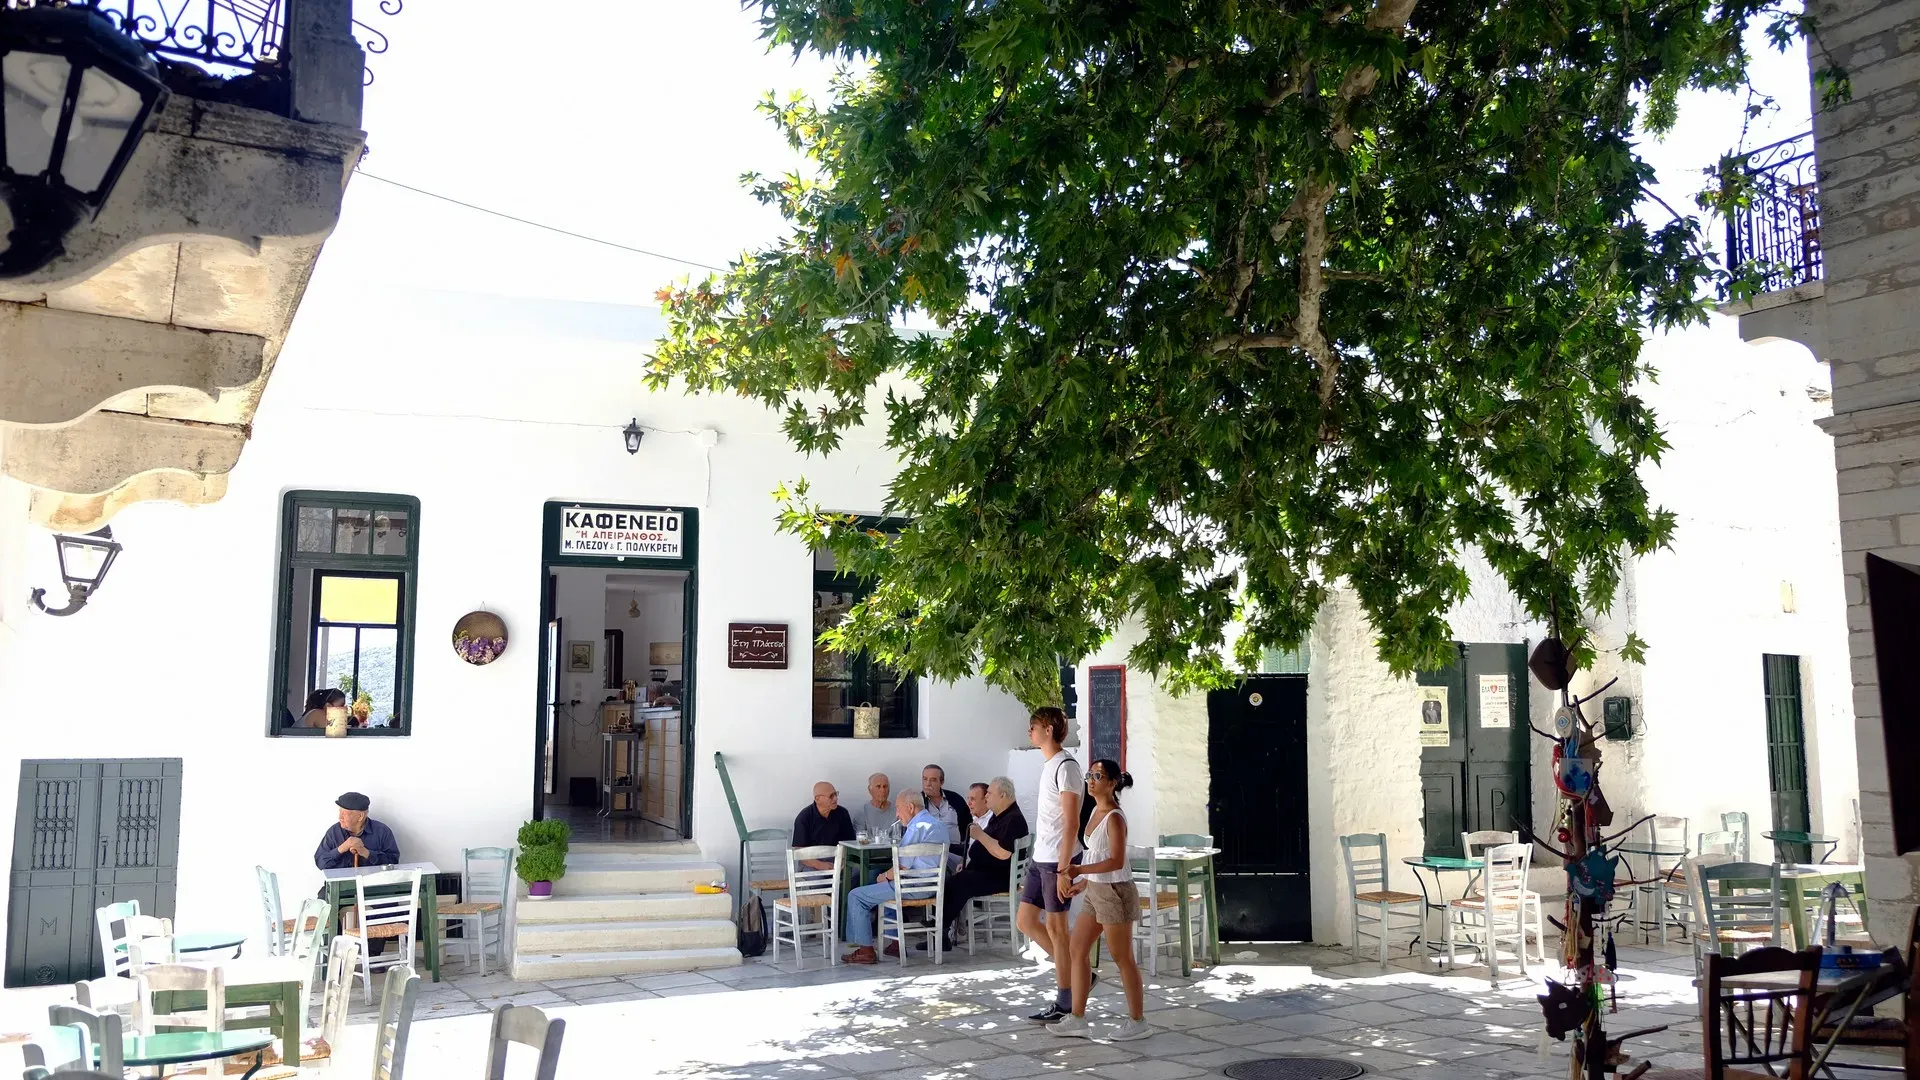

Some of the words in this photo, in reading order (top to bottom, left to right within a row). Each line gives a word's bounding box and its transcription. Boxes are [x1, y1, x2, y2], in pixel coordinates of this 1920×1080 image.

[565, 512, 678, 532] ΚΑΦΕΝΕΙΟ
[565, 540, 574, 549] Μ.
[576, 541, 609, 551] ΓΛΕΖΟΥ
[617, 542, 623, 551] Γ.
[626, 542, 678, 553] ΠΟΛΥΚΡΕΤΗ
[733, 640, 750, 648] Στη
[752, 640, 784, 648] Πλάτσα
